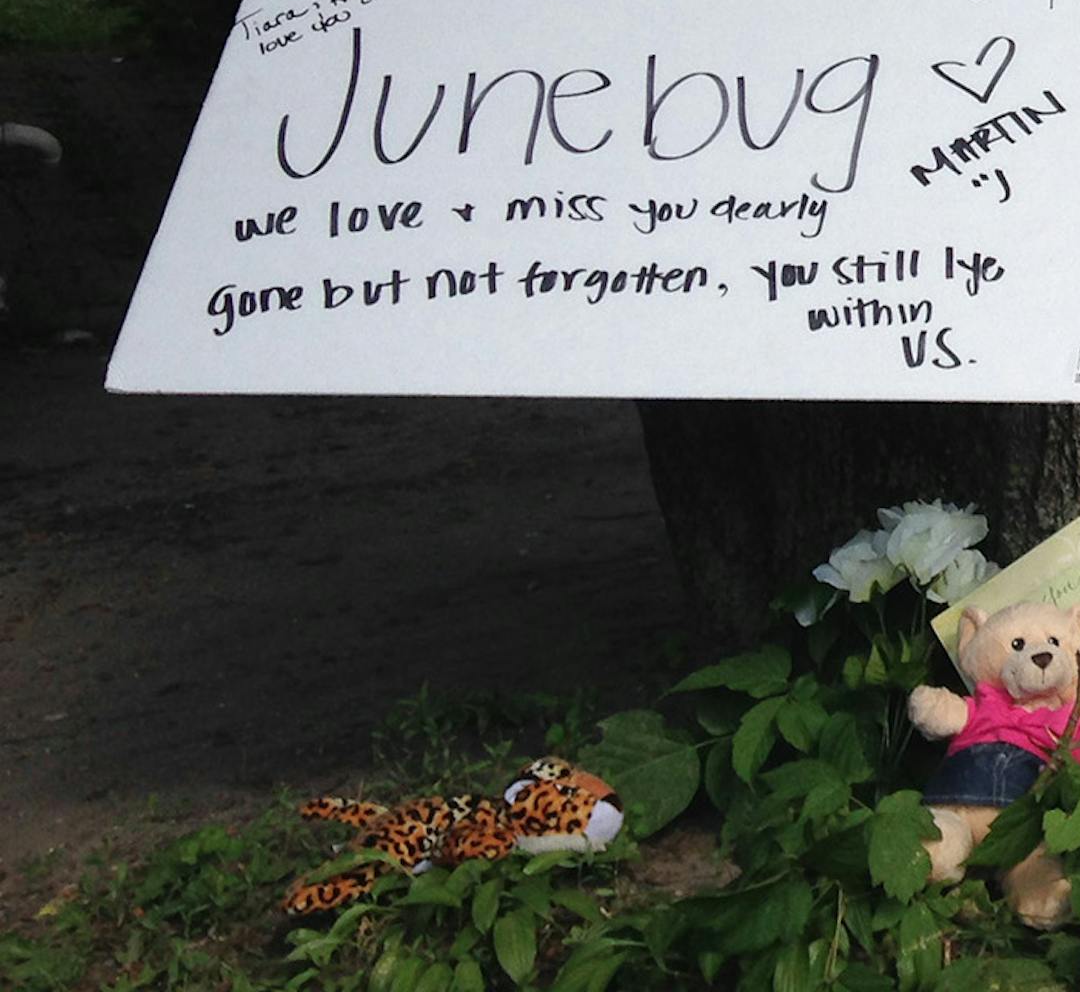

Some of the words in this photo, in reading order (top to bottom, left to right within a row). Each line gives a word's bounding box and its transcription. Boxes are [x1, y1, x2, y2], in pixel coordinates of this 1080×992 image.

[258, 30, 304, 55] love
[276, 25, 882, 194] Junebug
[909, 89, 1067, 188] MARTIN
[233, 203, 299, 243] we
[329, 200, 424, 238] love
[505, 190, 607, 223] miss
[627, 198, 698, 236] you
[709, 193, 830, 238] dearly
[205, 276, 304, 337] gone
[322, 269, 413, 311] but
[426, 260, 506, 297] not
[751, 260, 820, 302] you
[836, 248, 920, 287] still
[807, 298, 934, 333] within
